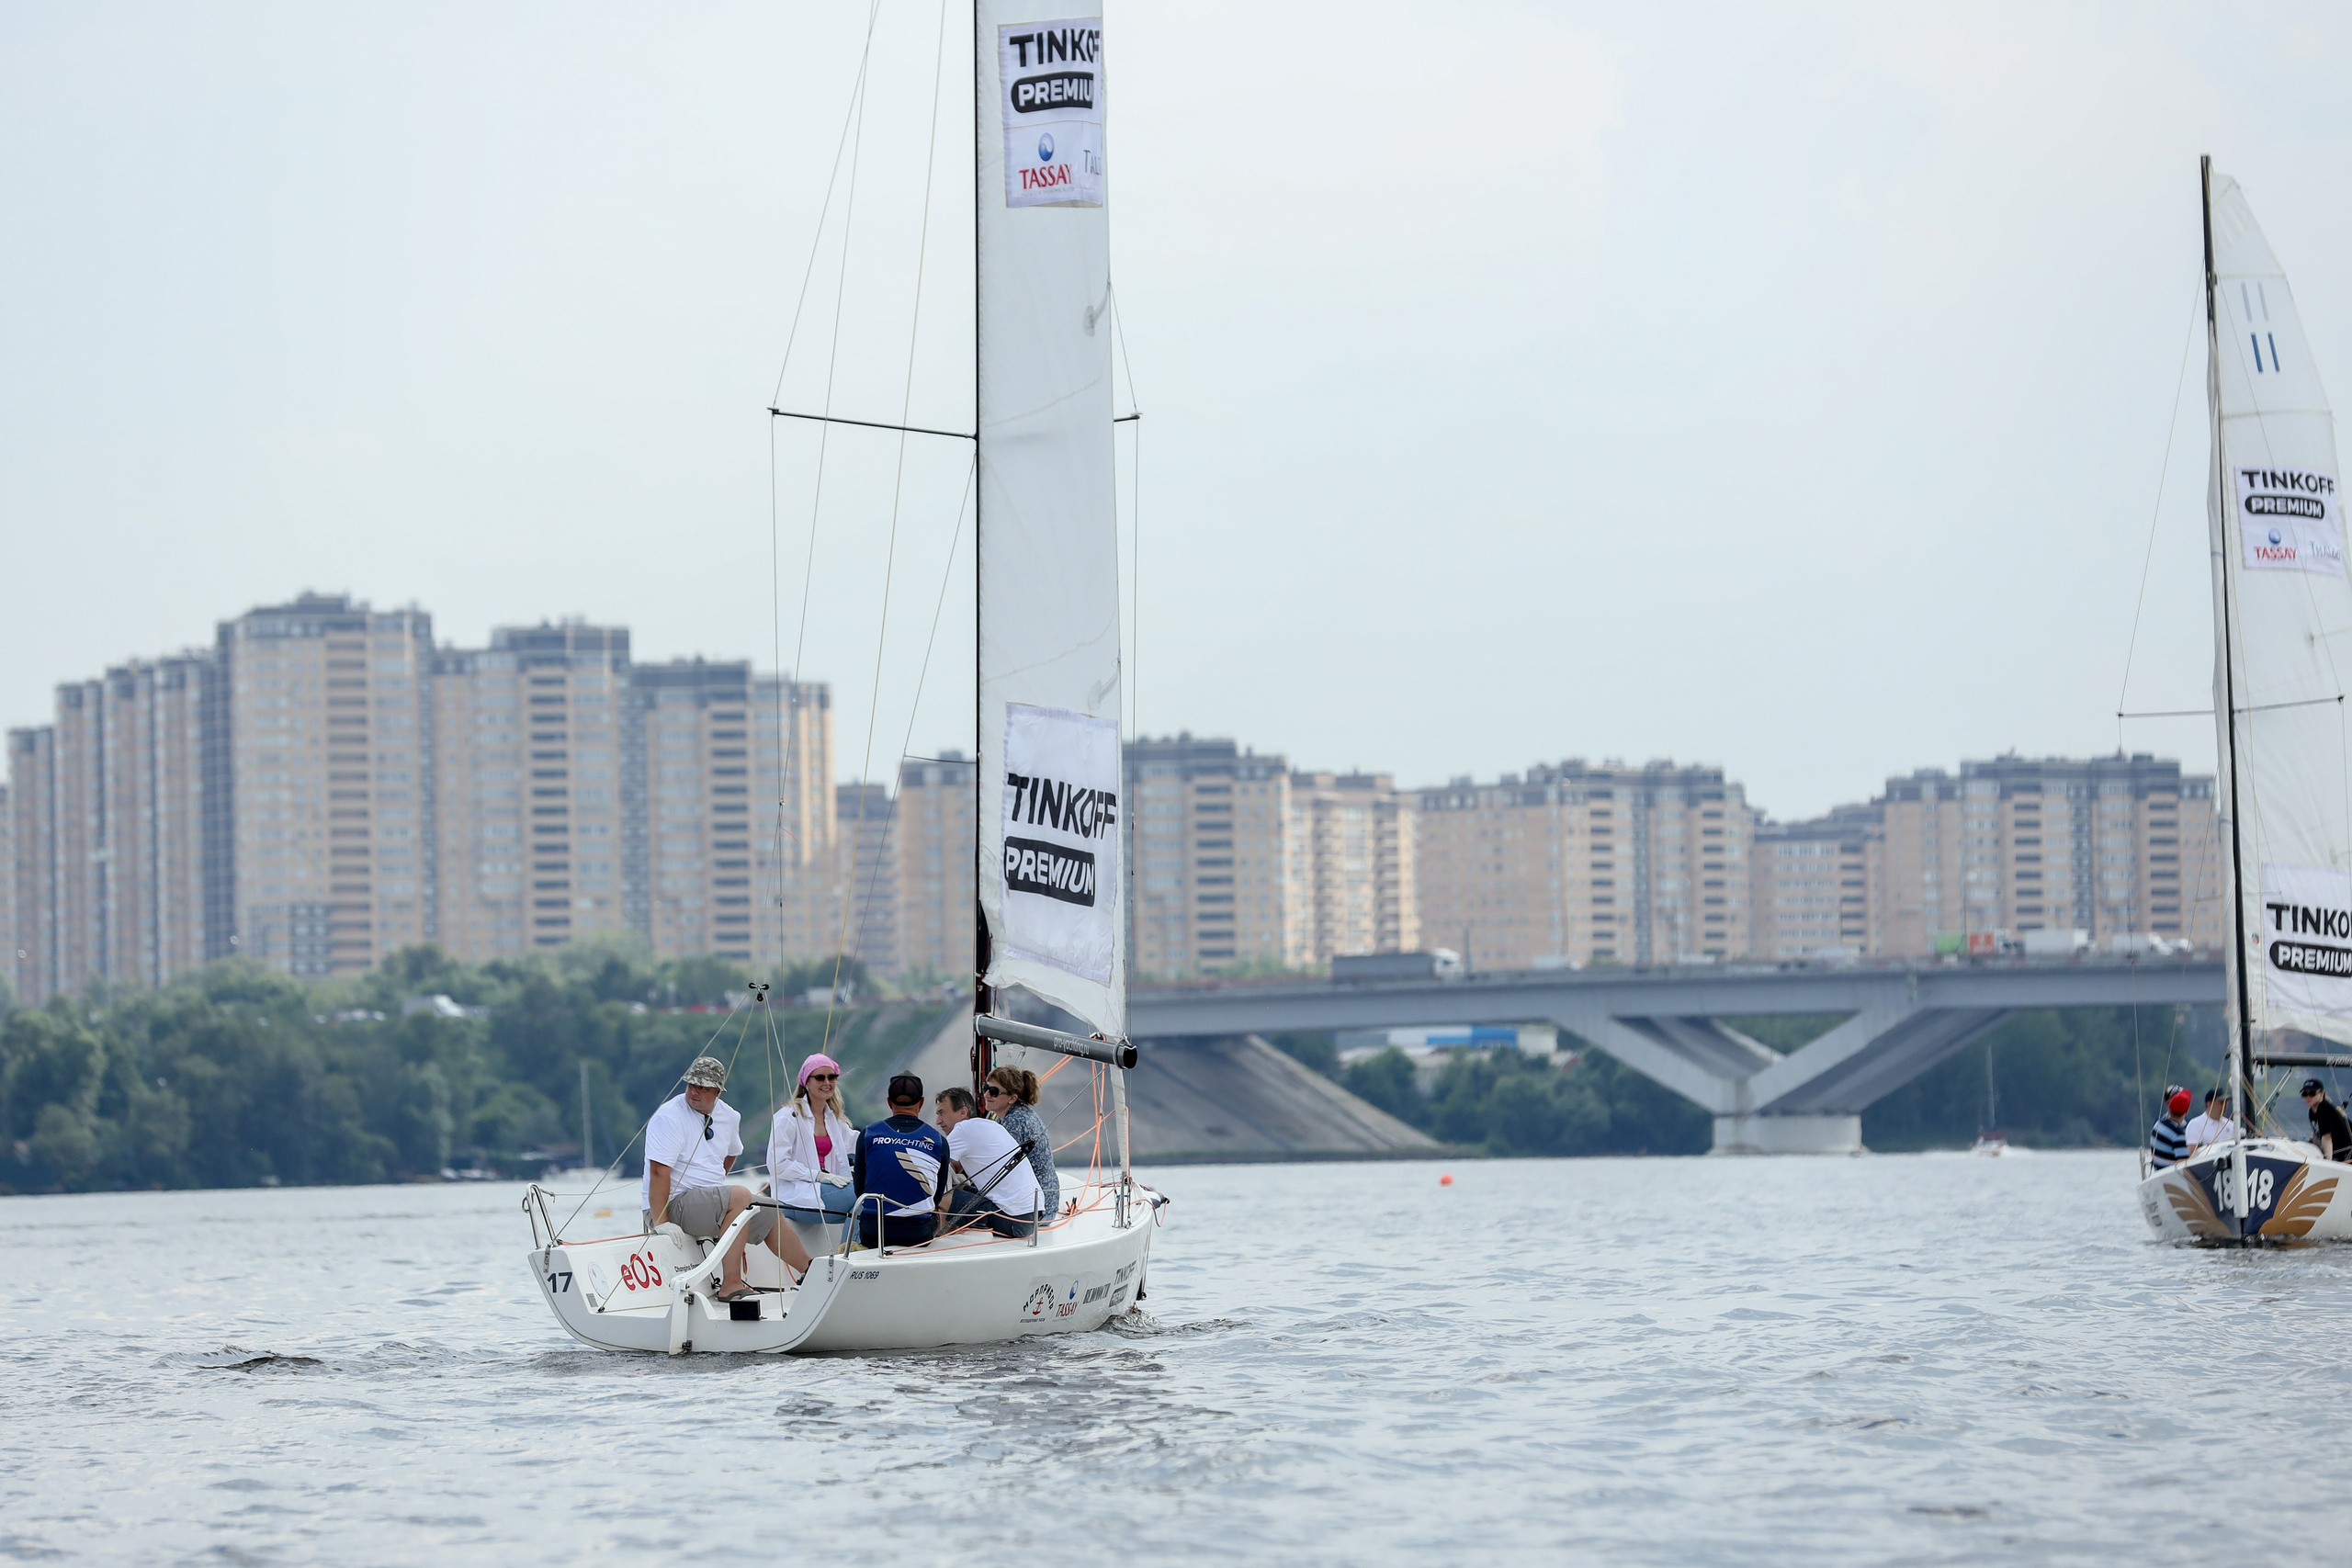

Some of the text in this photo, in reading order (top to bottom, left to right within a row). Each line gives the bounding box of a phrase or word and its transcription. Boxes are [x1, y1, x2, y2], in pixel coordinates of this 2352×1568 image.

[1018, 78, 1094, 107] PREMIU
[1018, 164, 1072, 189] TASSAY
[2241, 469, 2335, 496] TINKOFF
[2251, 497, 2323, 518] PREMIUM
[2254, 546, 2297, 561] TASSAY
[1007, 773, 1117, 840] TINKOFF
[1005, 845, 1095, 897] PREMIUM
[2266, 902, 2352, 939] TINKO
[2278, 943, 2352, 975] PREMIUM
[872, 1136, 934, 1151] PROYACHTING
[2212, 1168, 2235, 1213] 18
[2247, 1167, 2275, 1212] 18
[547, 1271, 573, 1293] 17
[849, 1270, 865, 1280] RUS
[1055, 1301, 1080, 1318] TASSAY
